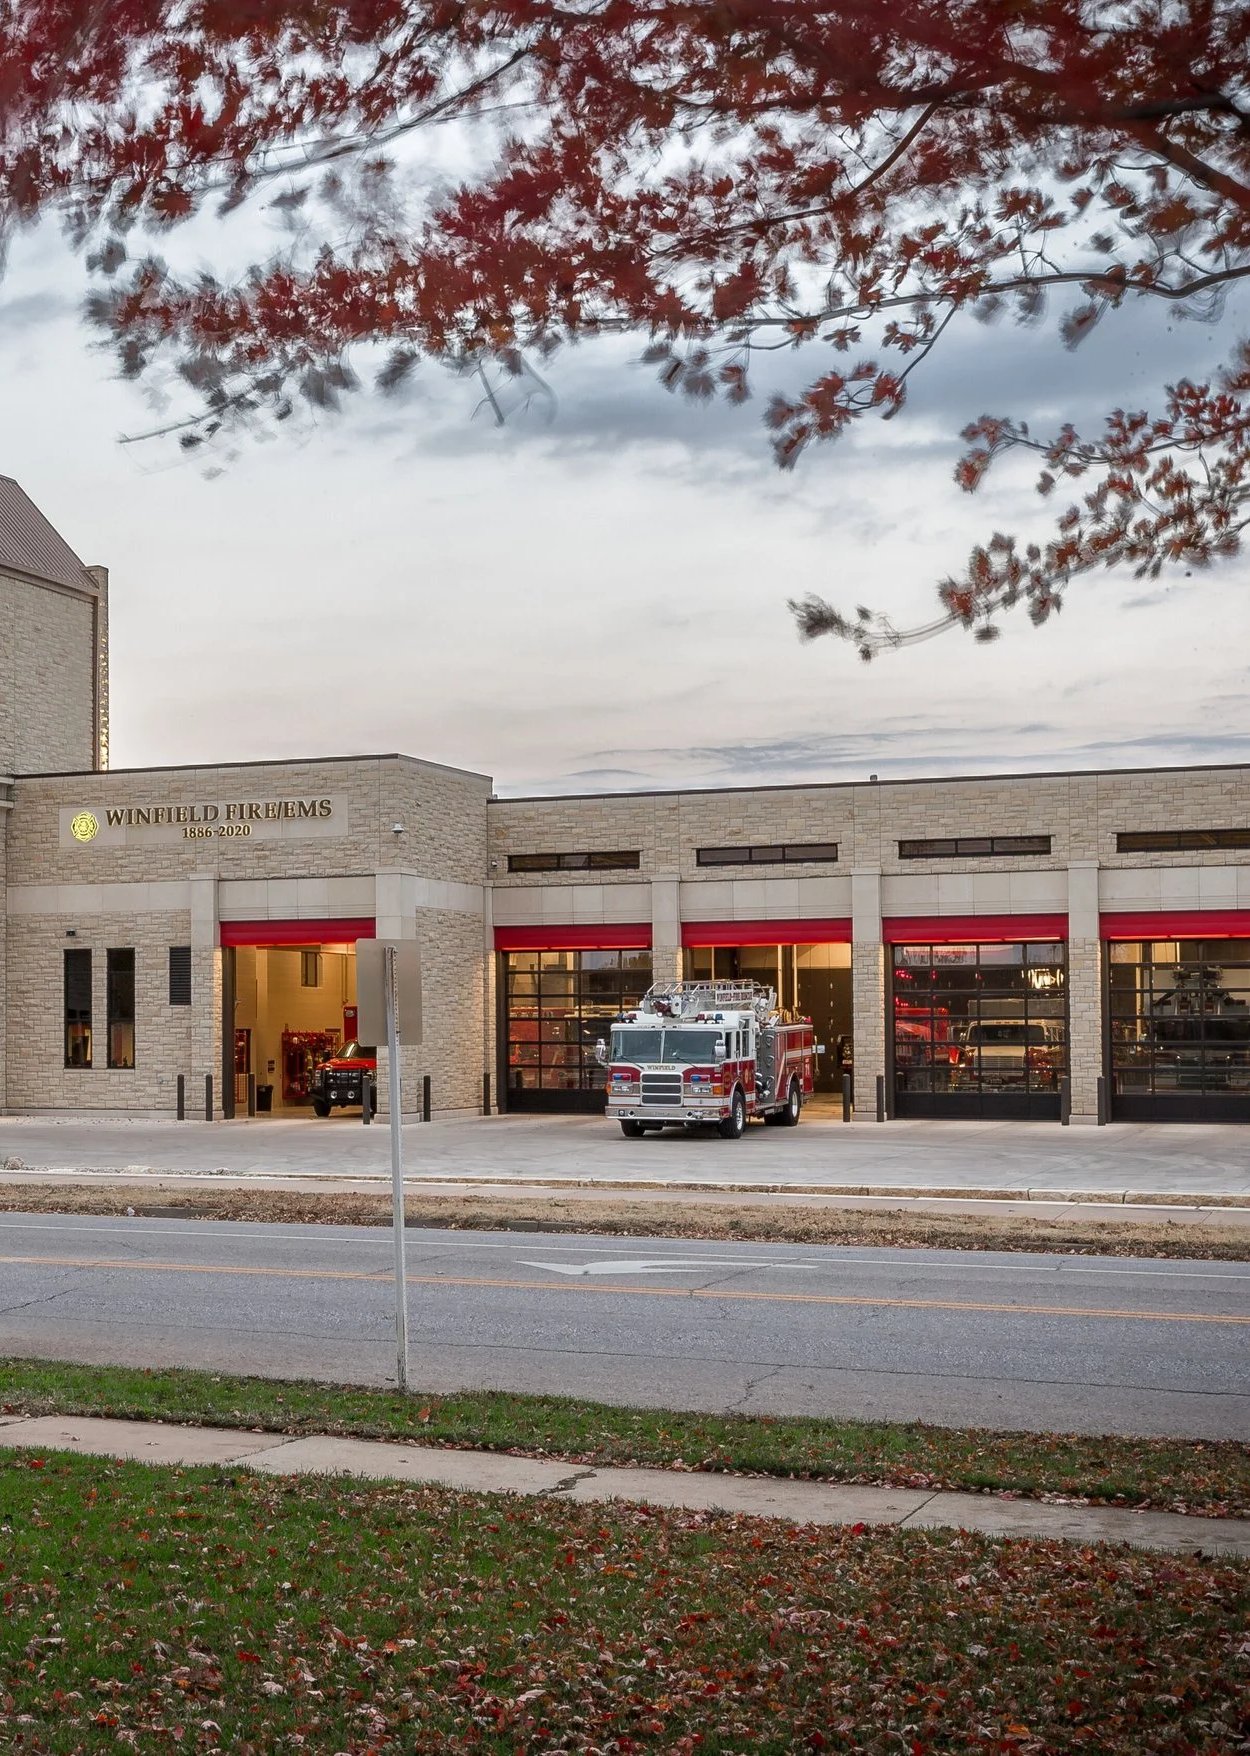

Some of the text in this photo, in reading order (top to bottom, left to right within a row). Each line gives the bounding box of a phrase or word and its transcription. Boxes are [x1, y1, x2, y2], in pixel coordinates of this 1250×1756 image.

[106, 799, 333, 826] WINFIELD FIRE/EMS
[182, 825, 251, 839] 1886-2020
